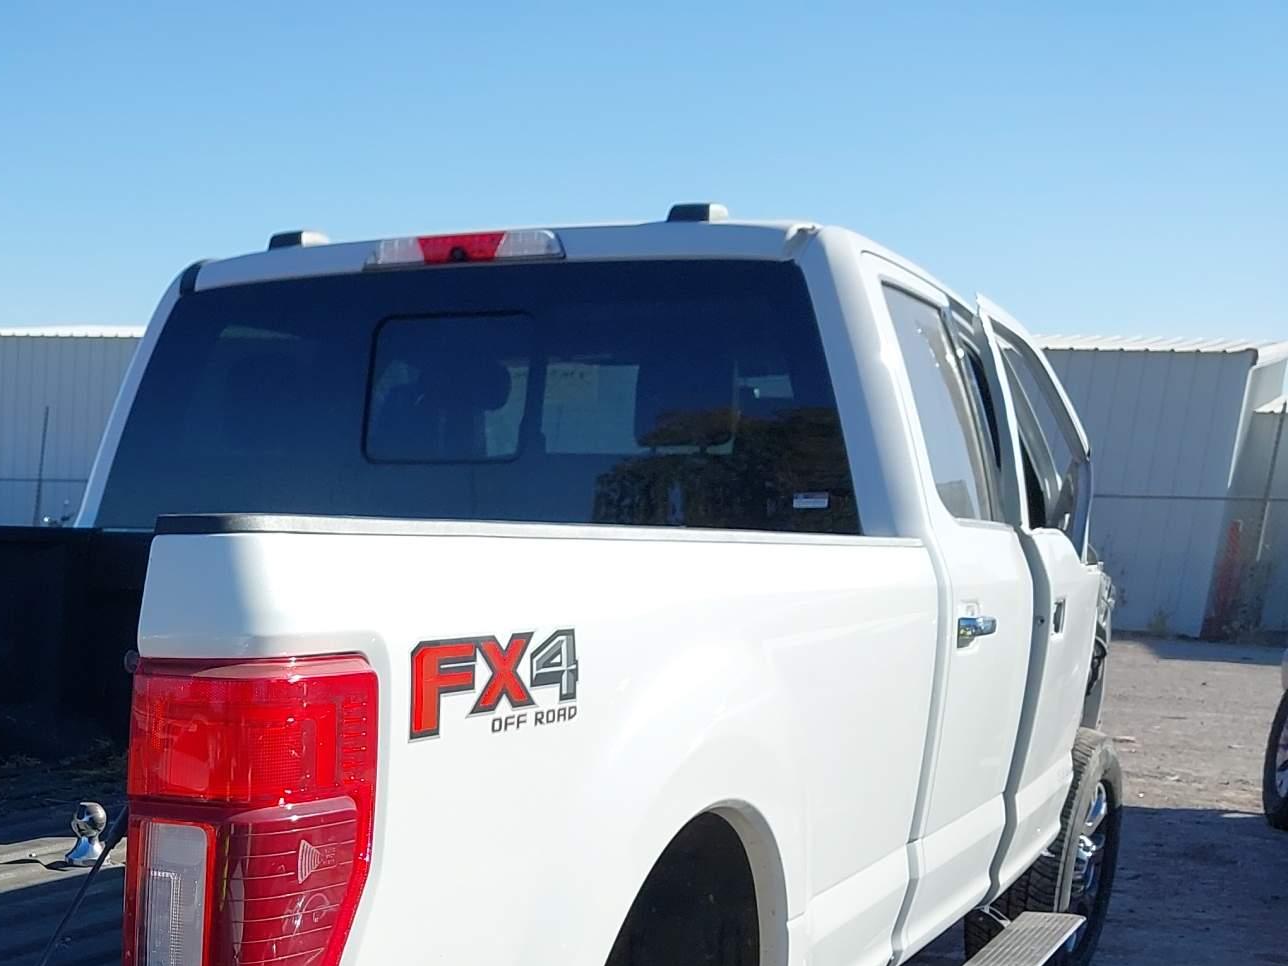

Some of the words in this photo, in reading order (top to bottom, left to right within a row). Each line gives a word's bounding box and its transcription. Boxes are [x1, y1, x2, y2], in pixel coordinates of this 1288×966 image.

[409, 628, 579, 742] FX4
[491, 712, 527, 733] OFF
[534, 706, 577, 727] ROAD
